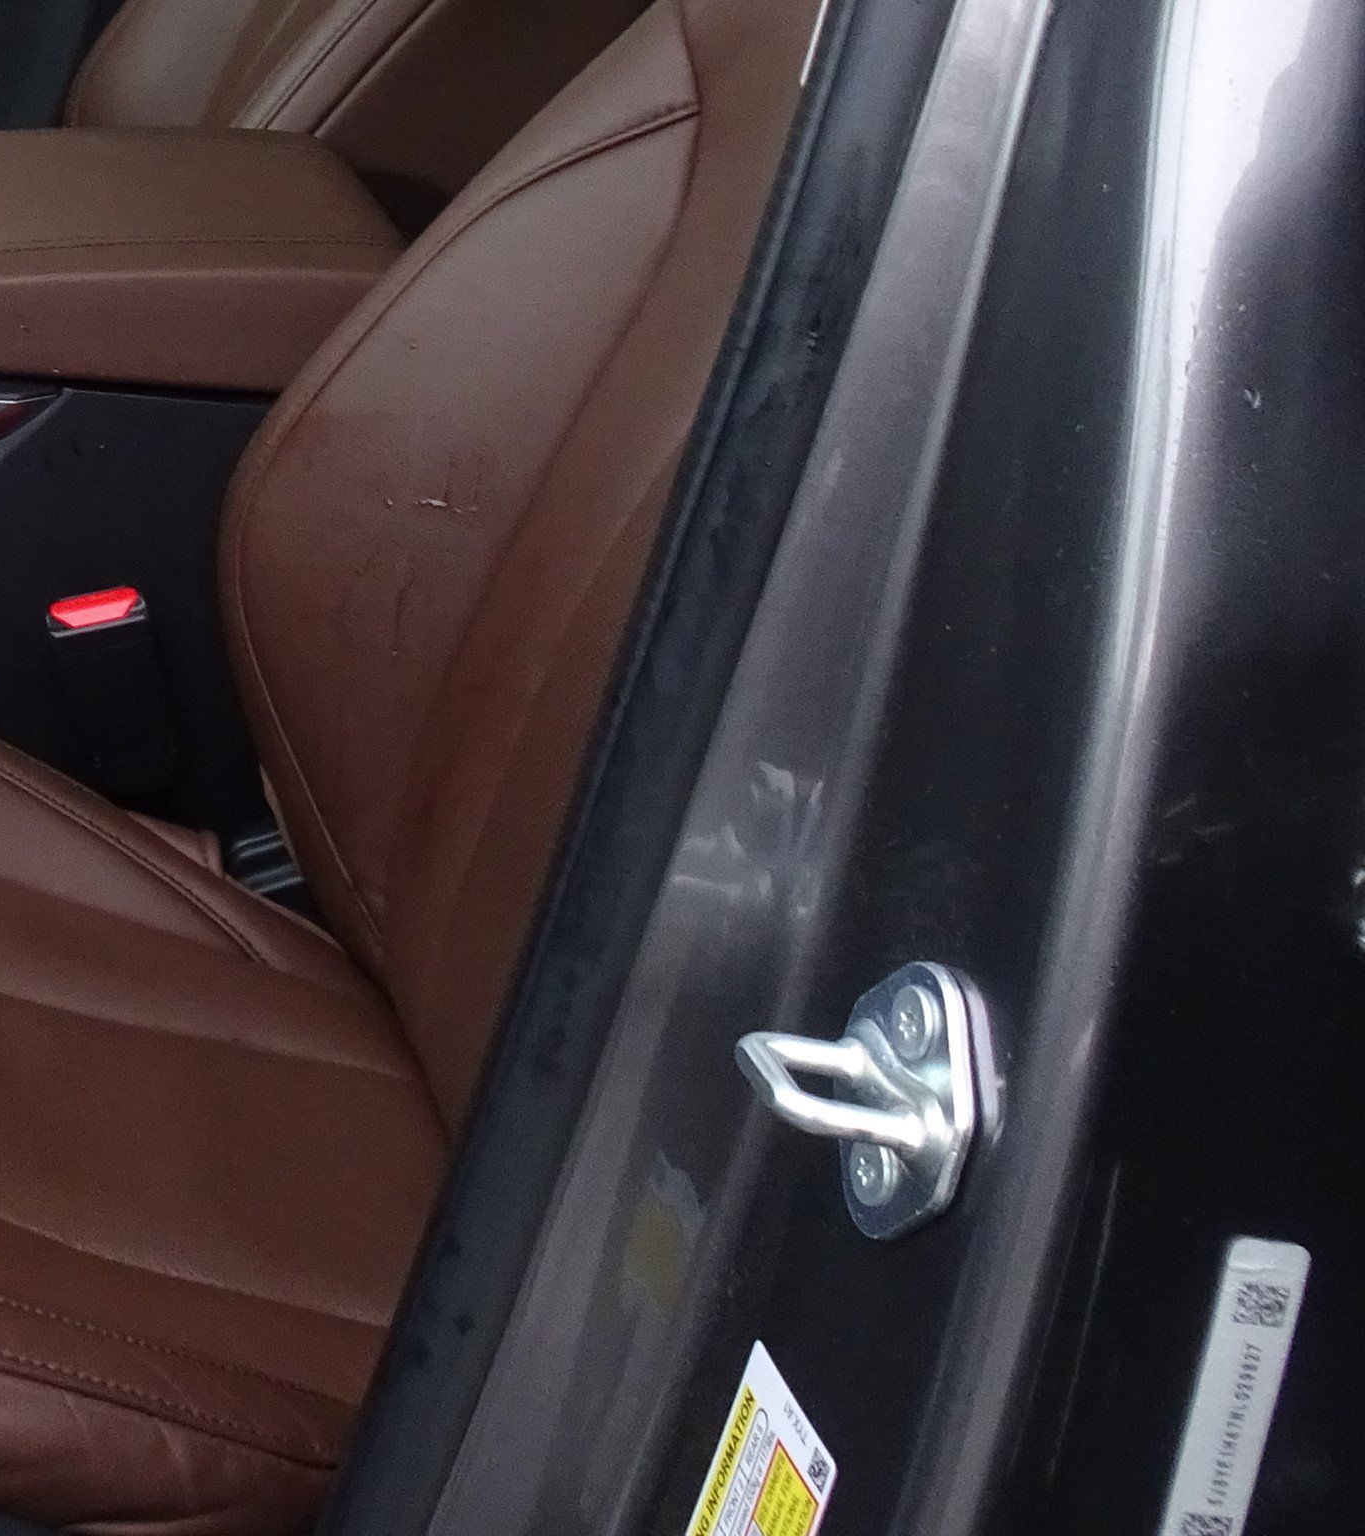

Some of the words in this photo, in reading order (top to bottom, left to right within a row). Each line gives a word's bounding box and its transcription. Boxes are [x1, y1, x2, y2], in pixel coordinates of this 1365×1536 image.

[706, 1389, 756, 1515] INFORMATION
[745, 1433, 760, 1467] REAR
[723, 1488, 741, 1529] FRONT
